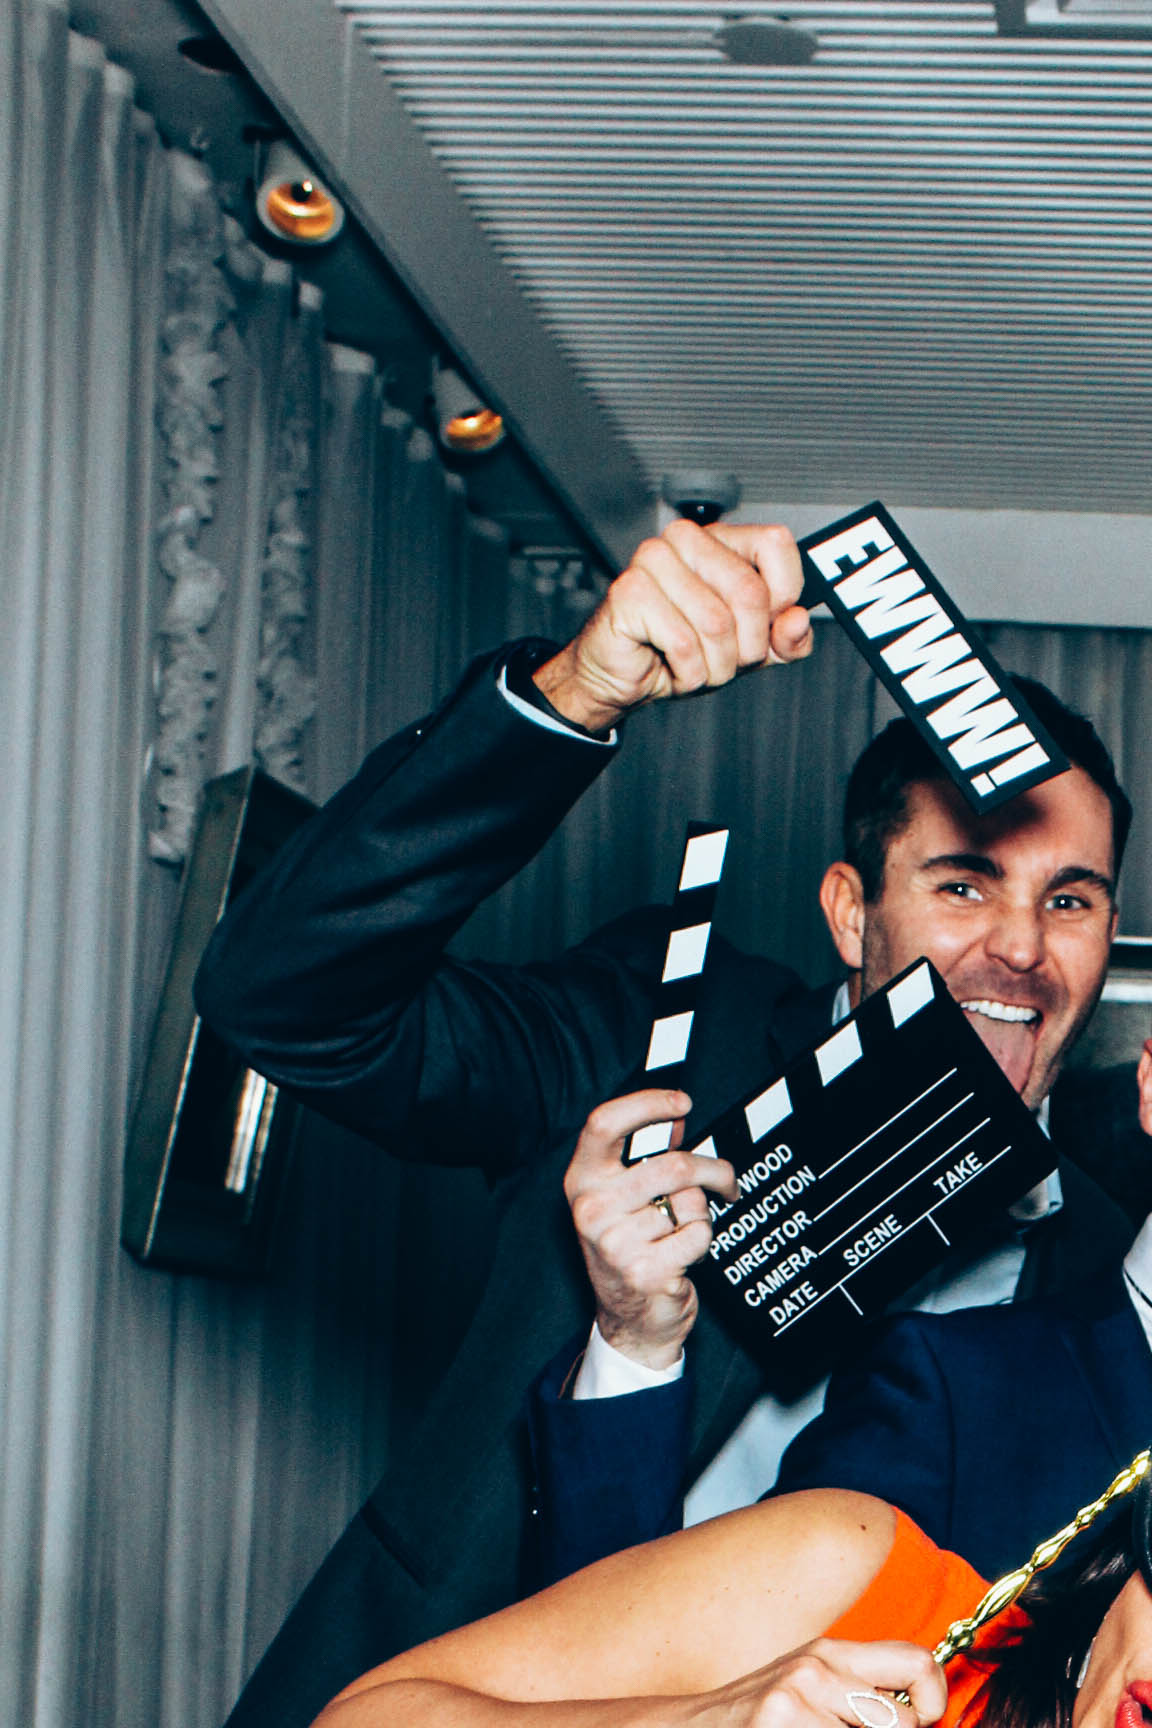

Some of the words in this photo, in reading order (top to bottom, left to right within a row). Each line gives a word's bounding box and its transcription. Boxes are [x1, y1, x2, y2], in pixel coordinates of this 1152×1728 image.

[807, 516, 1050, 797] EWWW!
[709, 1165, 817, 1260] PRODUCTION
[724, 1210, 813, 1285] DIRECTOR
[769, 1280, 818, 1325] DATE
[843, 1214, 902, 1267] SCENE
[933, 1151, 984, 1195] TAKE
[744, 1245, 818, 1307] CAMERA
